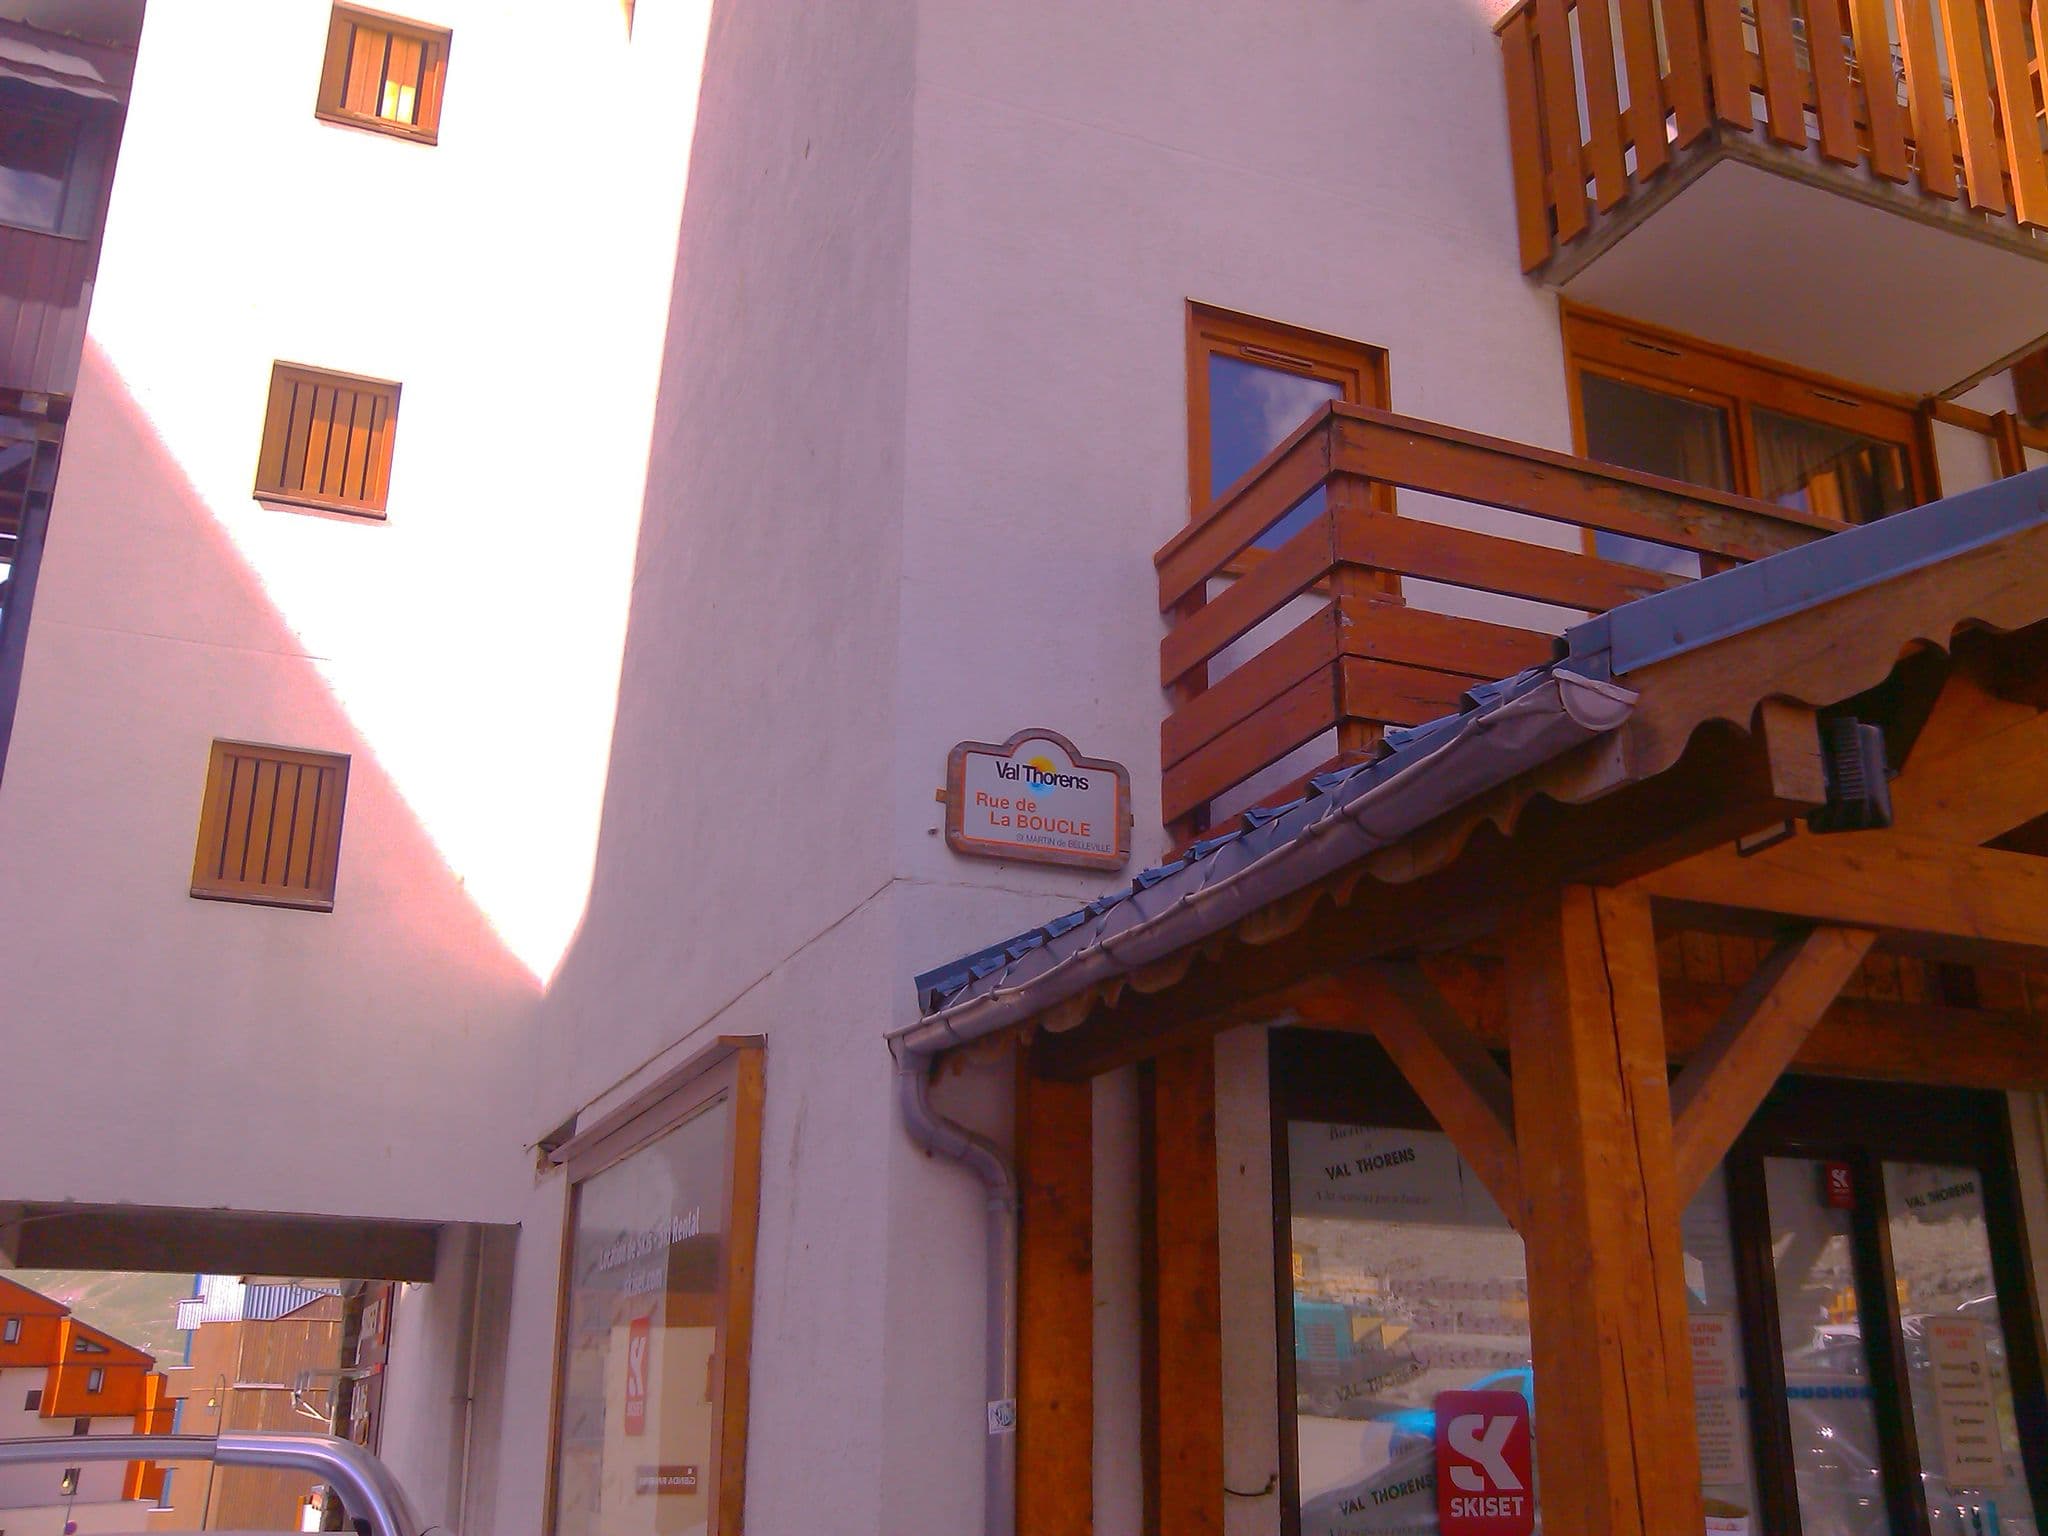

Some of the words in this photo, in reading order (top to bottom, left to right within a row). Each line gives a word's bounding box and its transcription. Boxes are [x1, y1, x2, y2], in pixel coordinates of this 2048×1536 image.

[995, 761, 1019, 781] Val
[1022, 764, 1089, 790] Thorens
[975, 791, 1009, 809] Rue
[1015, 798, 1037, 813] de
[990, 811, 1010, 826] La
[1016, 815, 1091, 837] BOUCLE
[1026, 834, 1056, 845] MARTIN
[1056, 839, 1066, 847] de
[1067, 839, 1111, 853] BELLEVILLE
[1325, 1163, 1351, 1180] VAL
[1356, 1148, 1415, 1174] THORENS
[1904, 1195, 1926, 1208] VAL
[1927, 1181, 1975, 1203] THORENS
[672, 1206, 700, 1244] Rental
[1339, 1497, 1365, 1515] VAL
[1369, 1474, 1433, 1505] THORENS
[1450, 1496, 1524, 1518] SKISET
